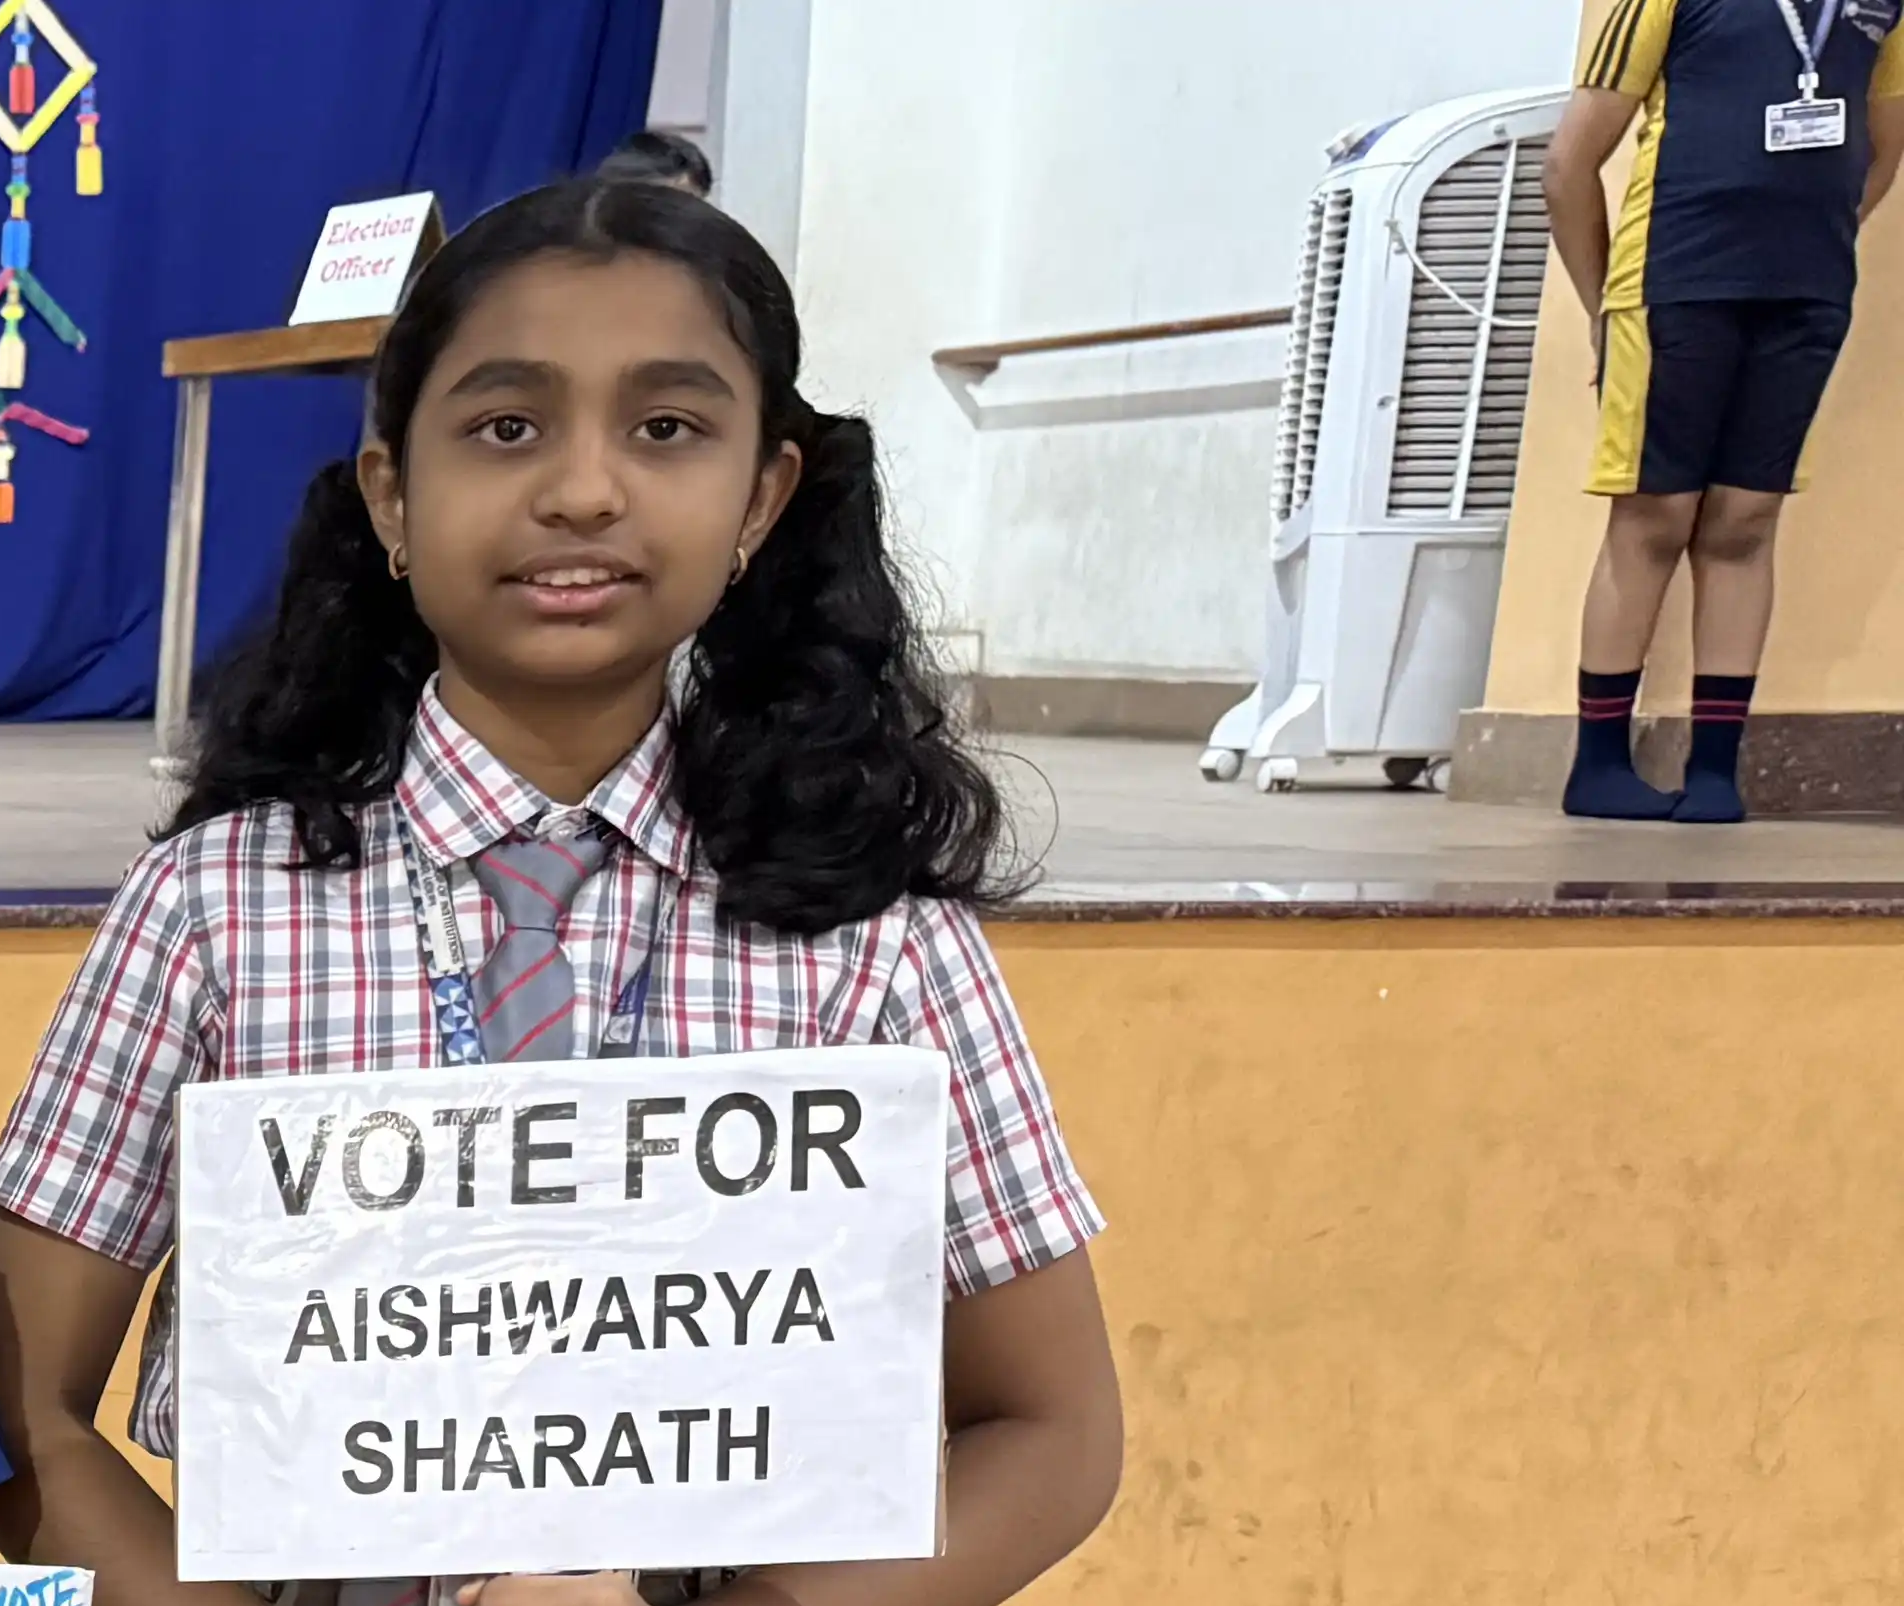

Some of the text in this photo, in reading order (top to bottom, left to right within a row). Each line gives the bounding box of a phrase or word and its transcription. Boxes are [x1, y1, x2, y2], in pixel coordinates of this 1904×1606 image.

[320, 255, 396, 283] Officer
[327, 213, 415, 246] Election
[259, 1088, 867, 1216] VOTE FOR
[283, 1266, 836, 1365] AISHWARYA
[341, 1405, 771, 1496] SHARATH
